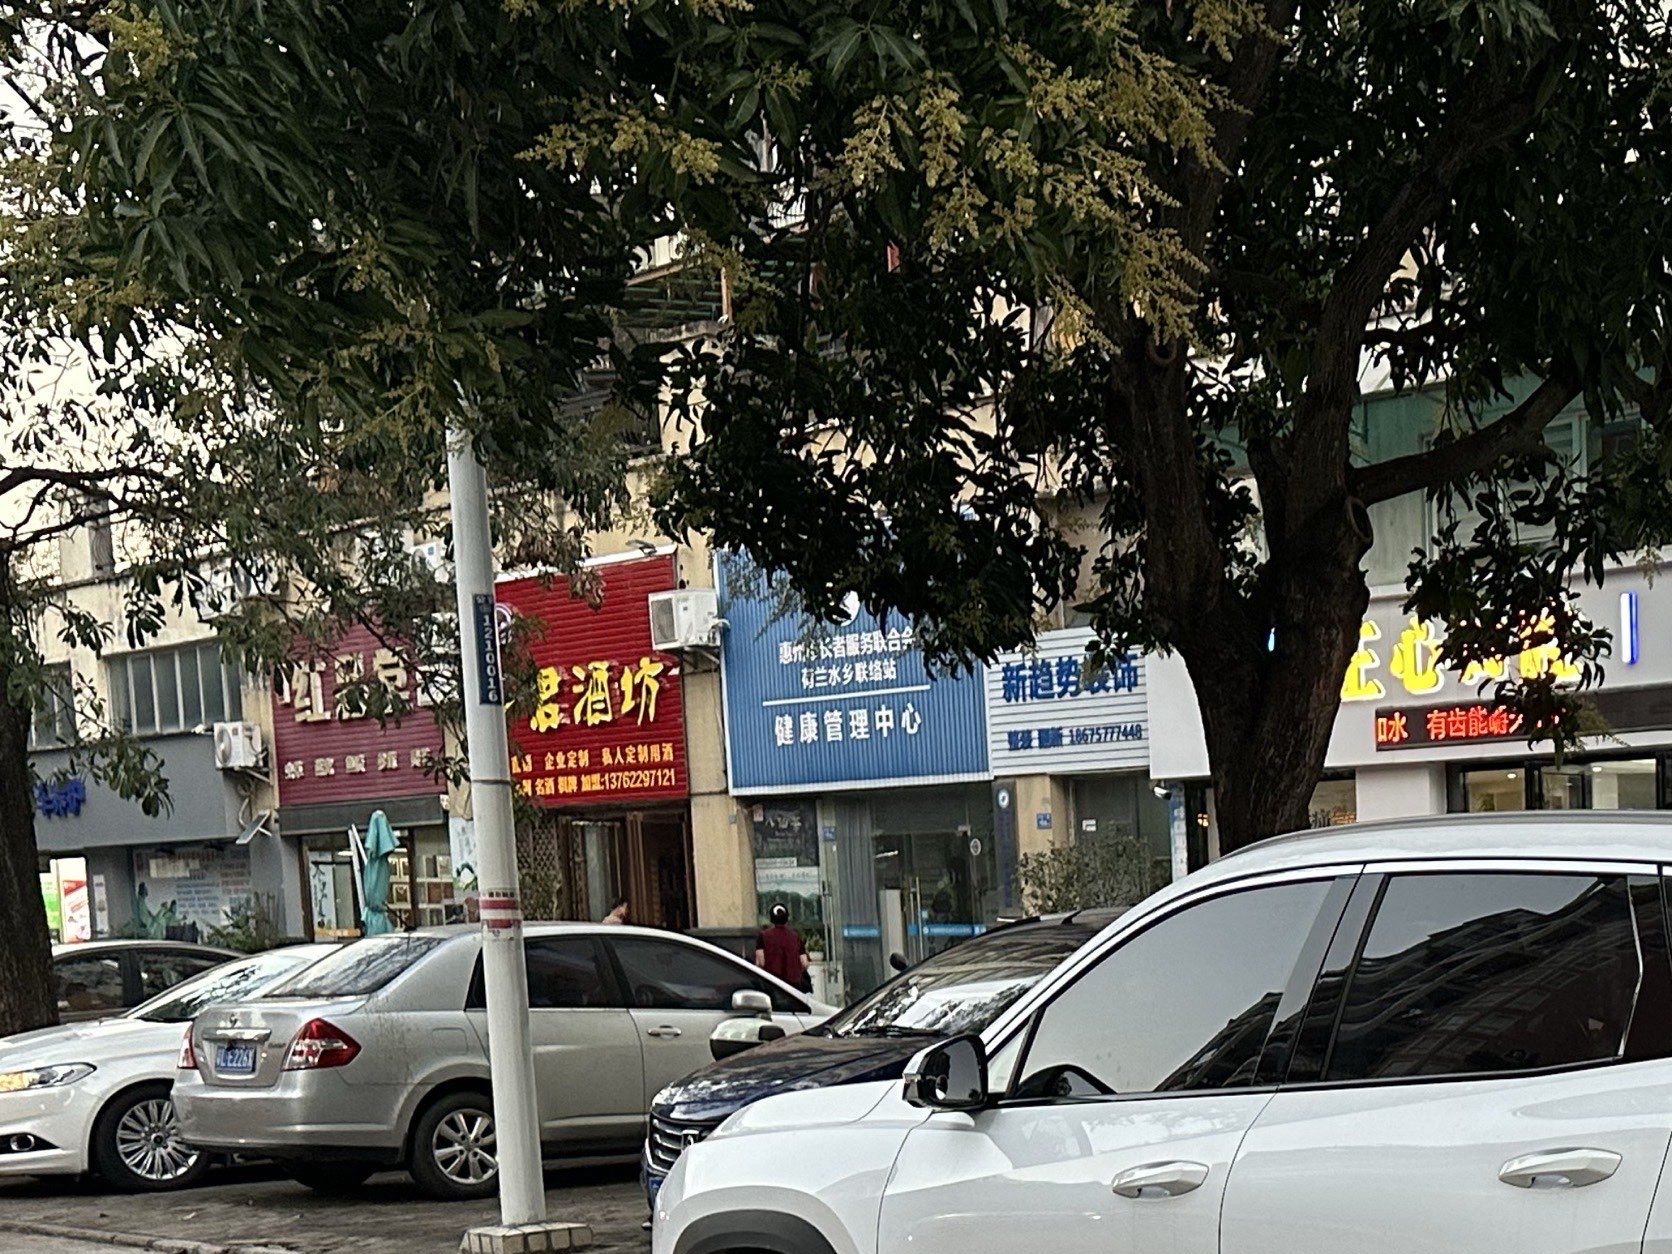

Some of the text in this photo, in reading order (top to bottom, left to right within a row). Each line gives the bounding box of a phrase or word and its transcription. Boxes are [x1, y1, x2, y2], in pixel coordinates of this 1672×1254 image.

[483, 614, 499, 702] 1210016
[774, 702, 922, 747] 健康管理中心
